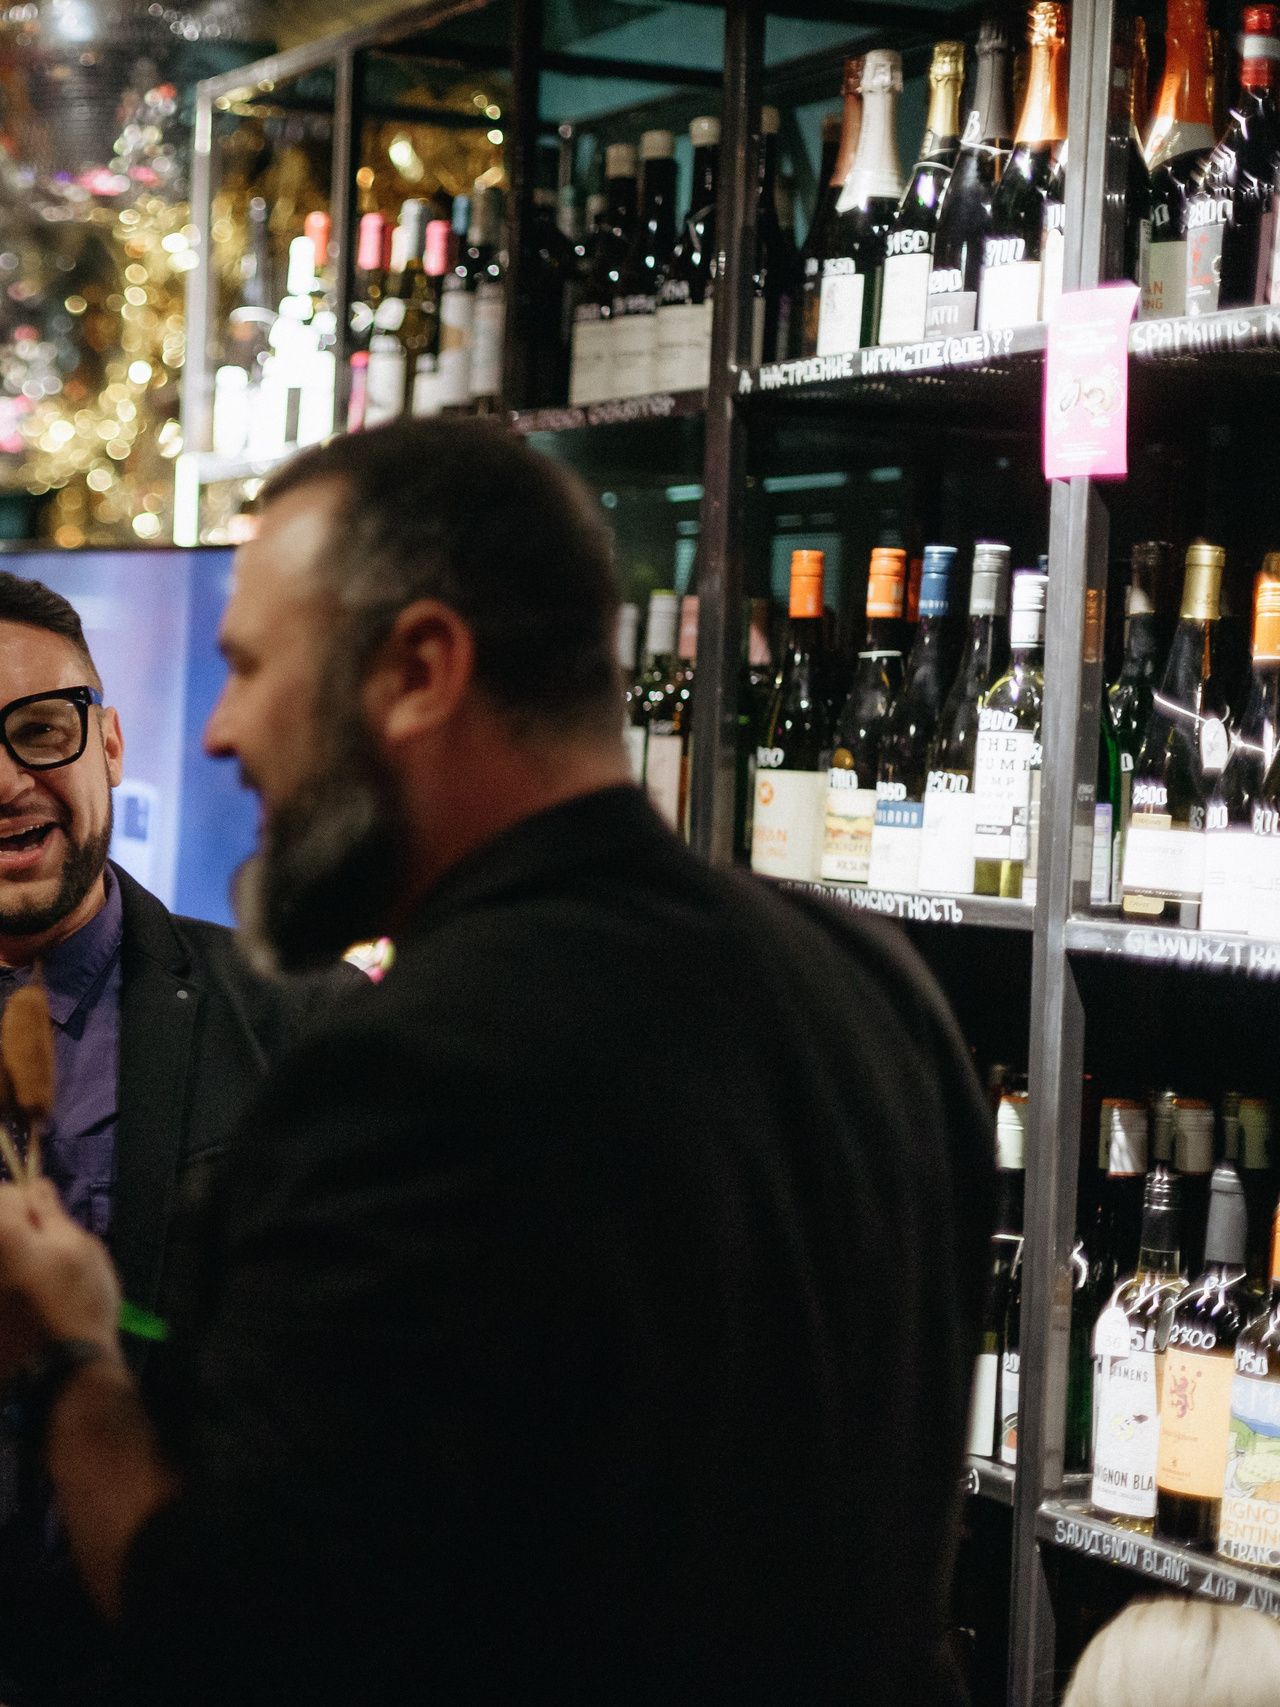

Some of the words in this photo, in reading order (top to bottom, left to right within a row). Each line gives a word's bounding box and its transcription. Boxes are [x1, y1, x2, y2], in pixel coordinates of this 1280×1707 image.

[1133, 1474, 1158, 1492] BLA
[1055, 1520, 1138, 1566] SAUVIGNON
[1142, 1549, 1190, 1587] BLANC
[1198, 1572, 1237, 1601] ДЛЯ
